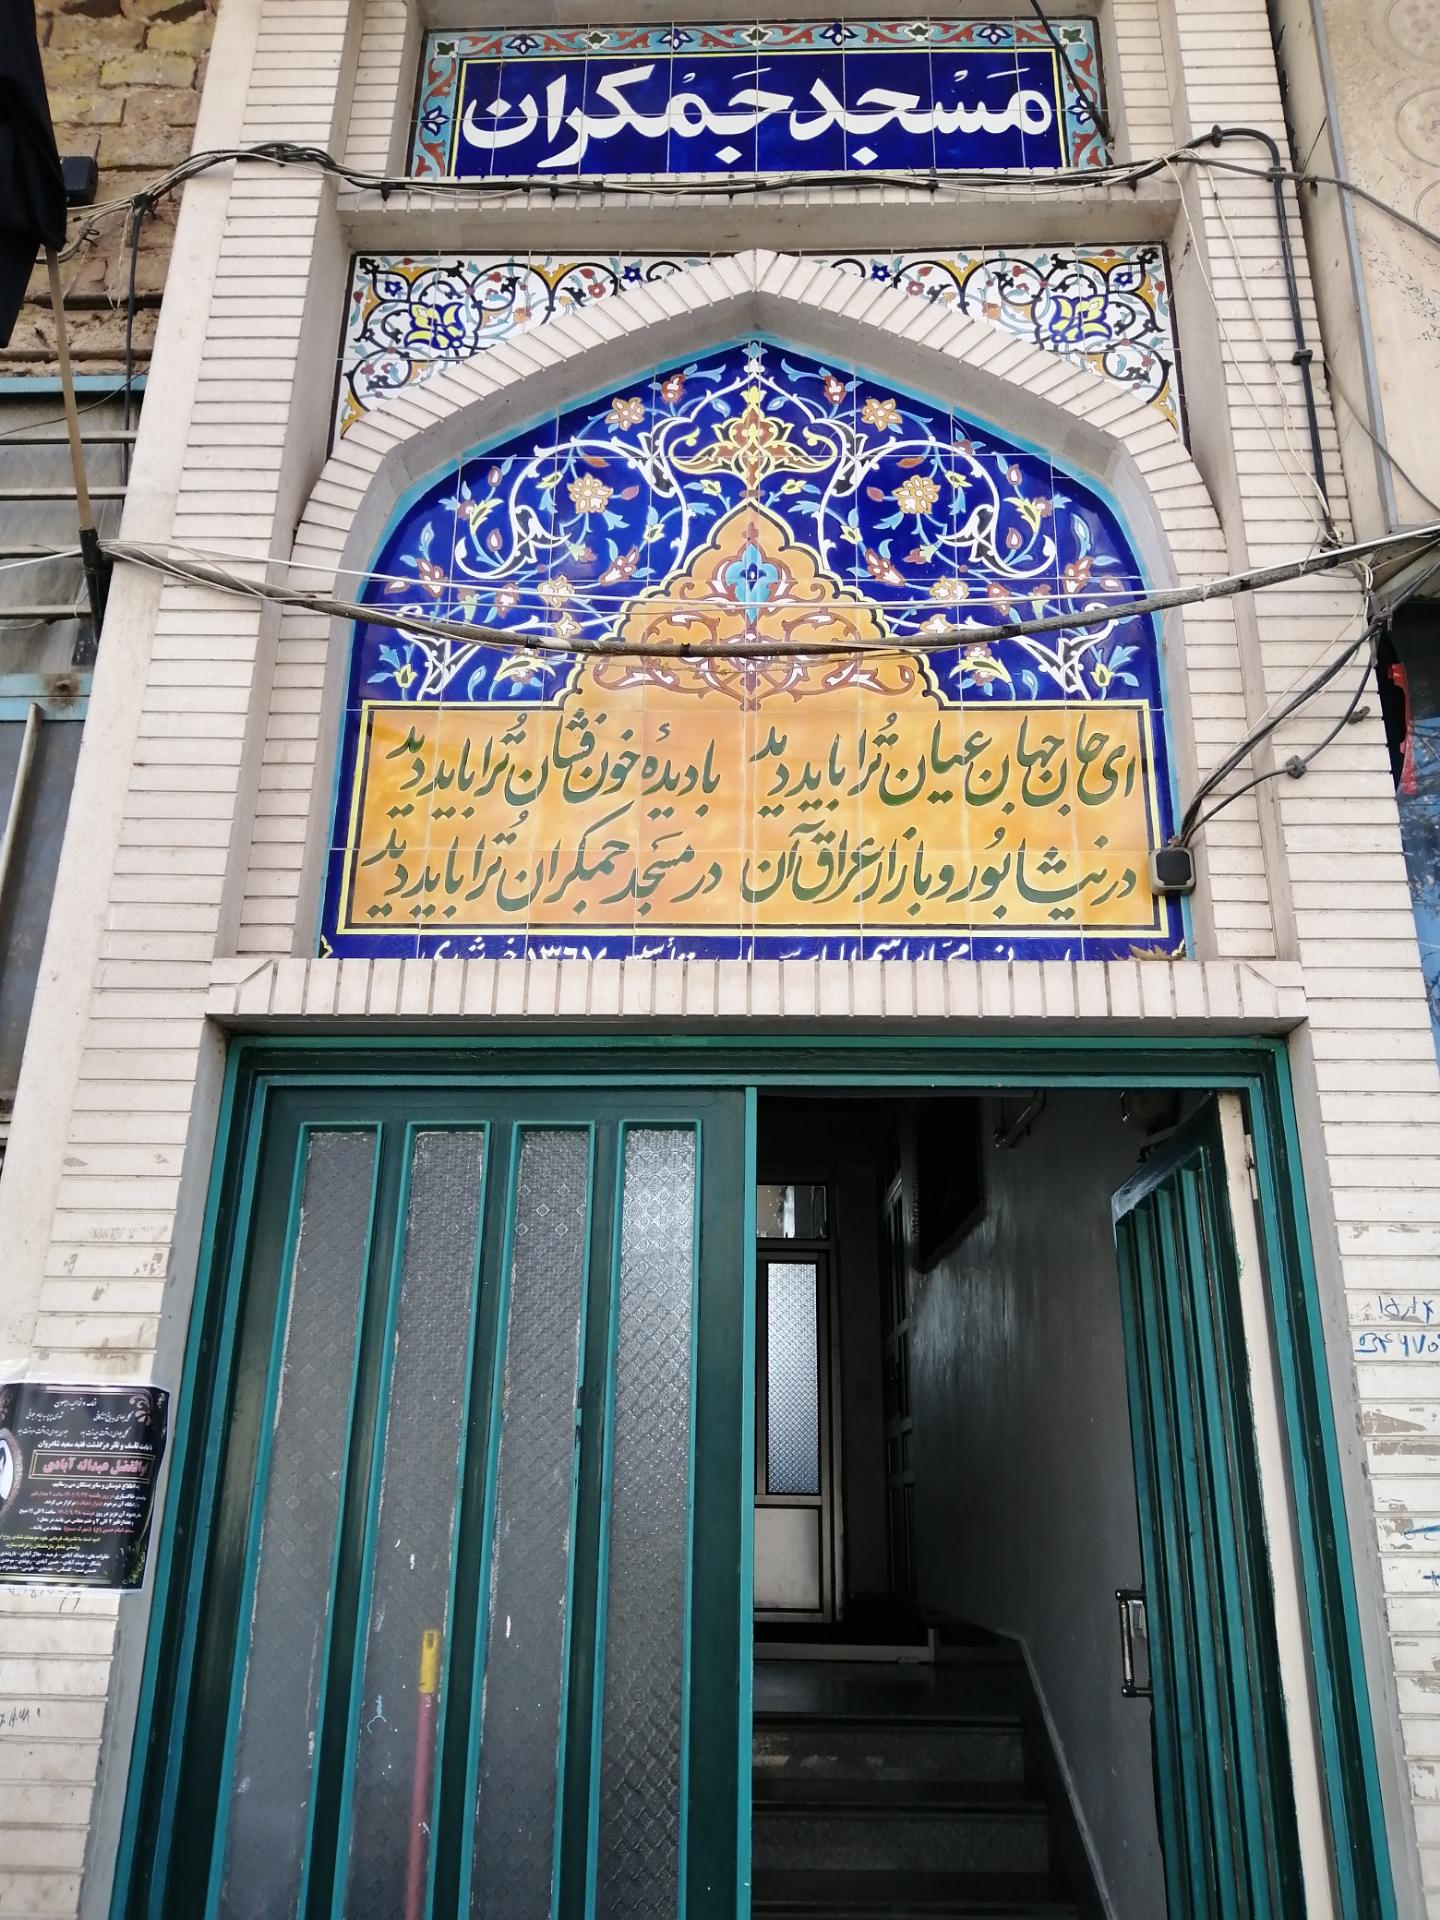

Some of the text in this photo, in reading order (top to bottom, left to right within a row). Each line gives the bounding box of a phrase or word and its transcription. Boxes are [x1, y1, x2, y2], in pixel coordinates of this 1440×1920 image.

[562, 728, 642, 804] خون
[694, 738, 721, 817] با
[497, 800, 636, 915] جمکران
[669, 861, 723, 904] در
[792, 829, 885, 905] عراق
[1089, 867, 1137, 907] در
